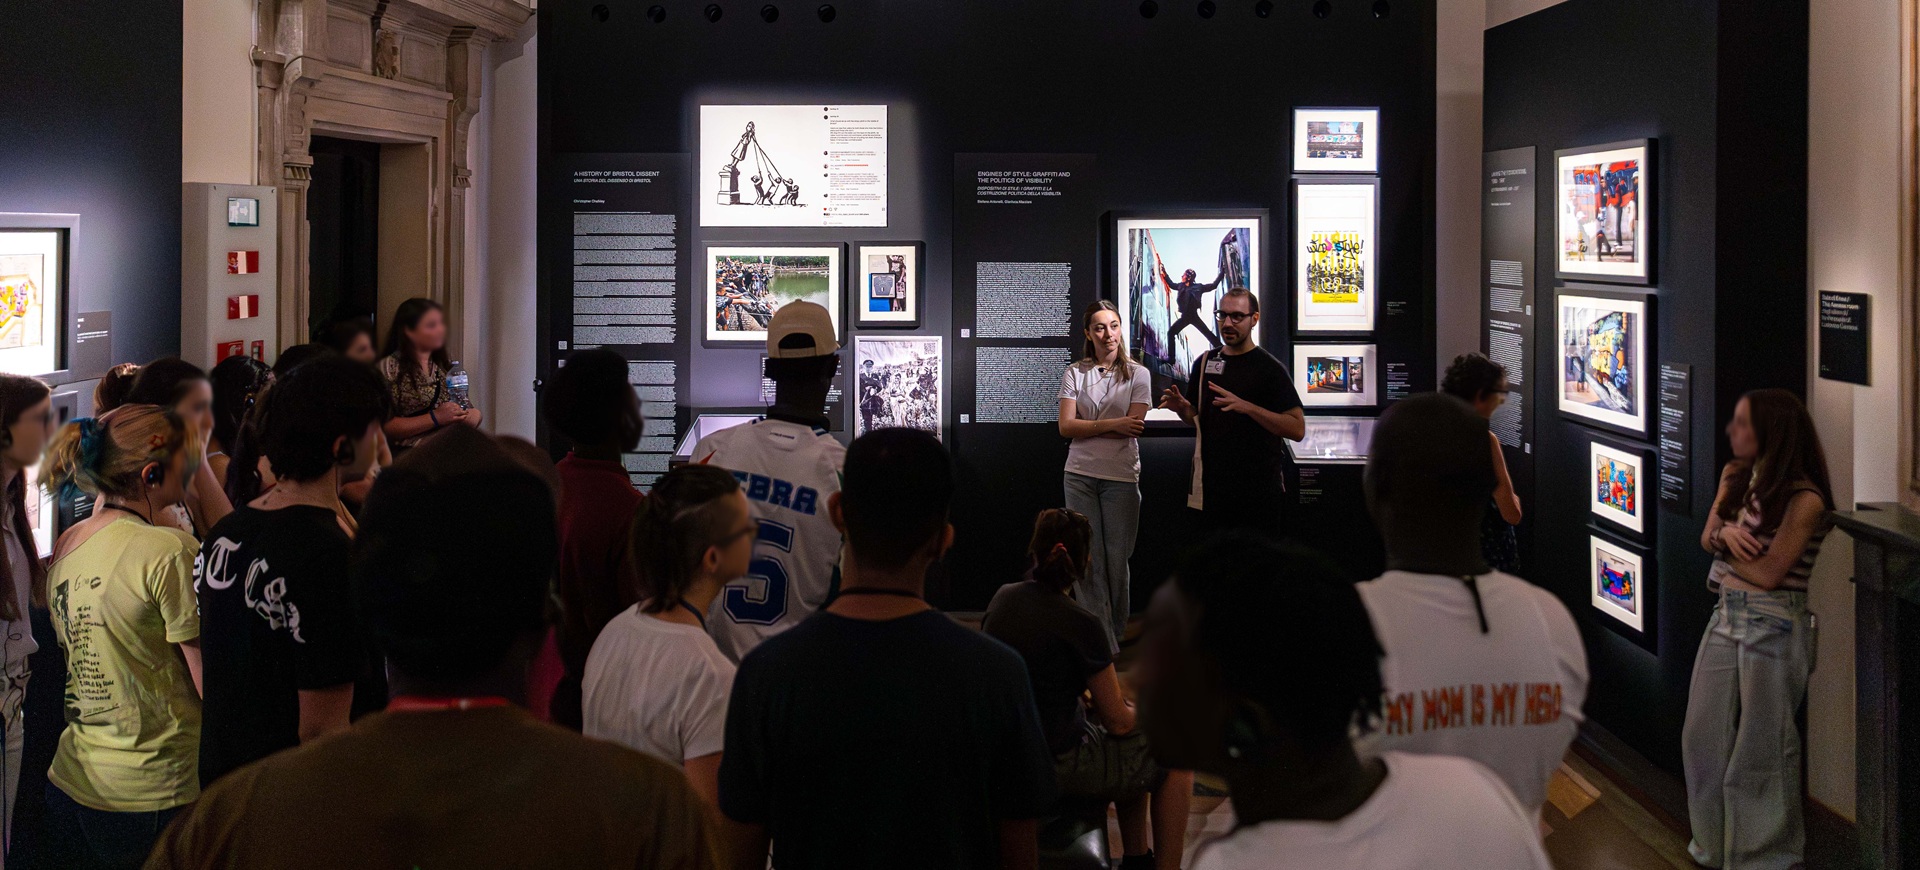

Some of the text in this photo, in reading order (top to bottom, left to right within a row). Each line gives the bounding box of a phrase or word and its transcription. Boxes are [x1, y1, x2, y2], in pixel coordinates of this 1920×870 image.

[731, 469, 818, 516] BRA
[722, 518, 795, 626] 5
[1385, 690, 1414, 735] MY
[1420, 684, 1464, 731] MOM
[1471, 683, 1484, 726] IS
[1491, 682, 1518, 726] MY
